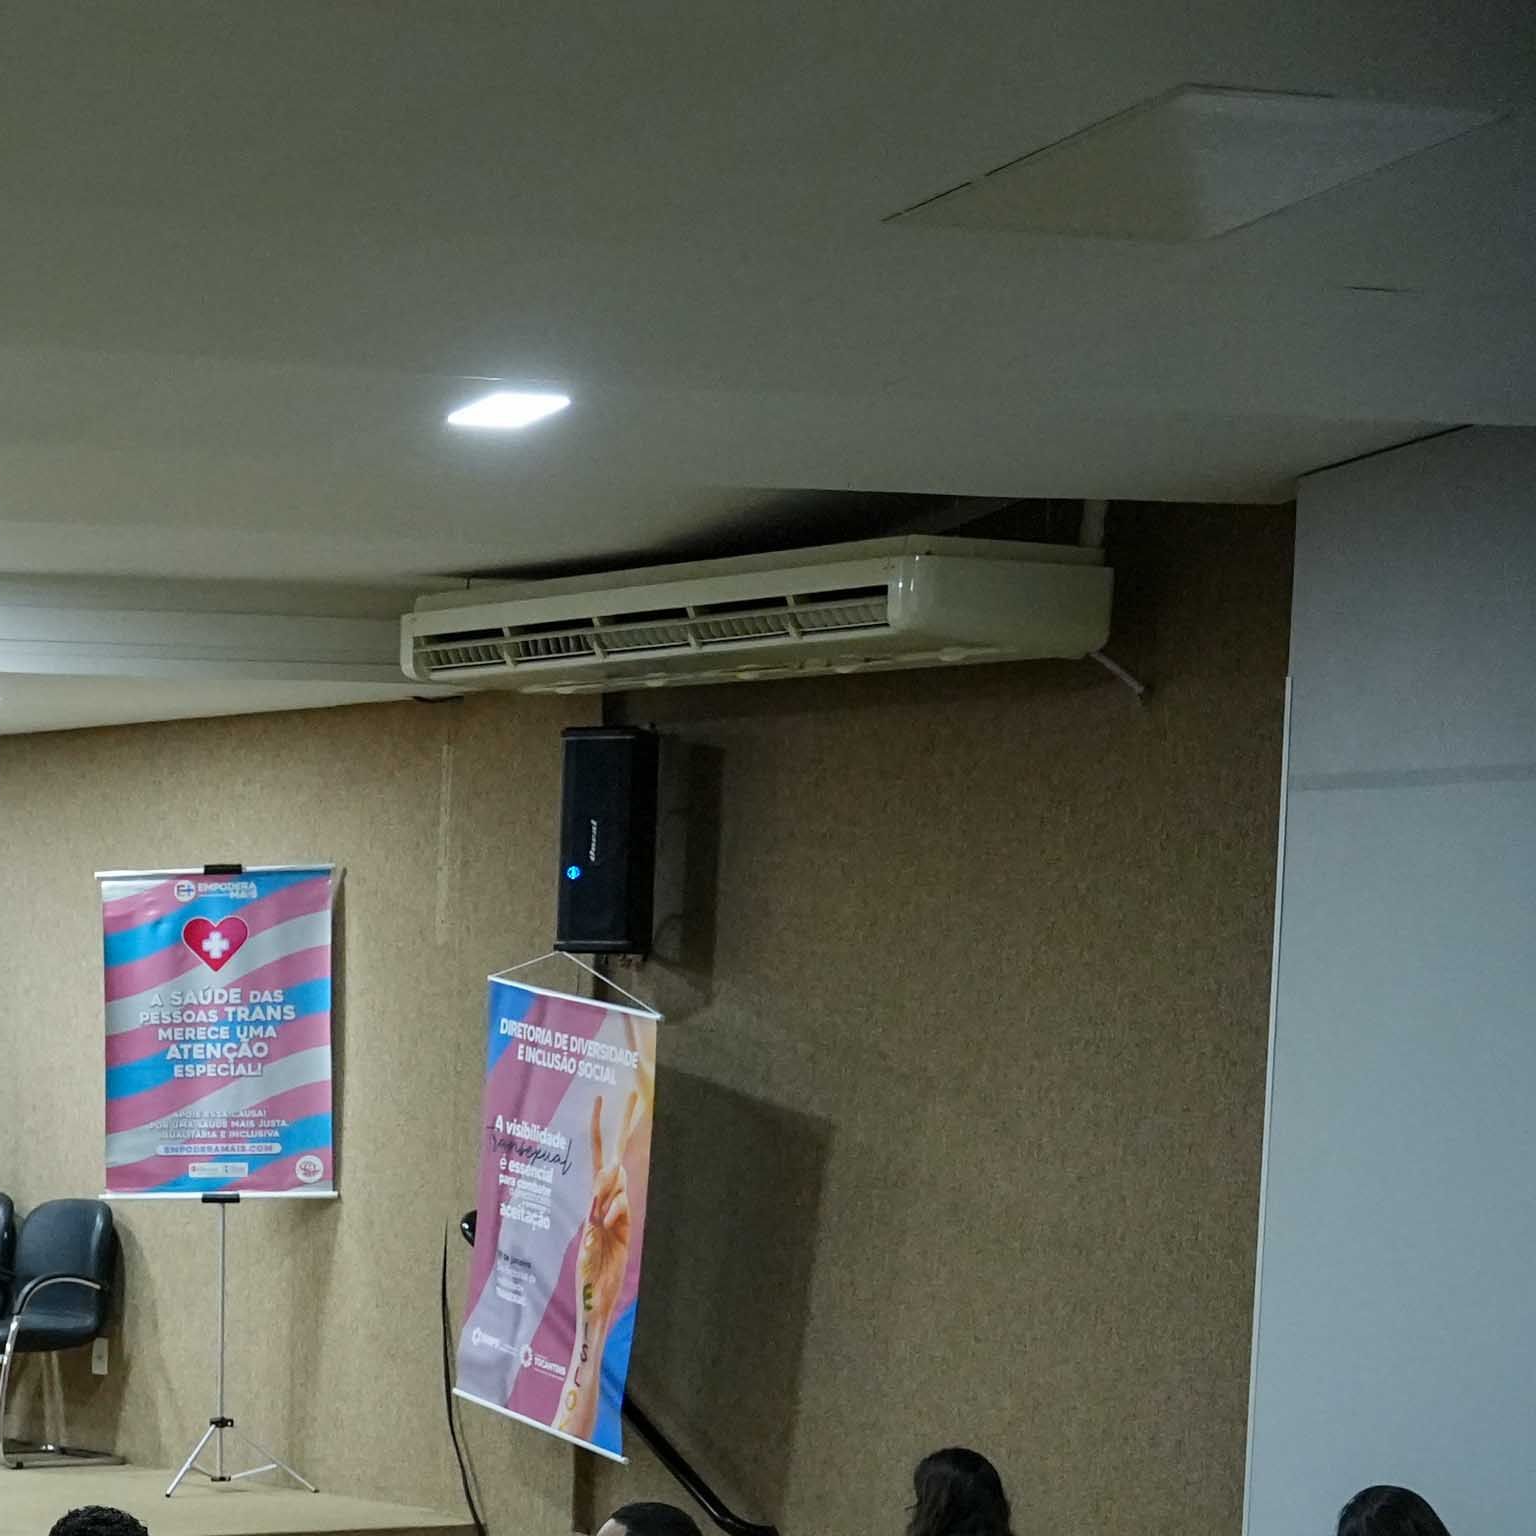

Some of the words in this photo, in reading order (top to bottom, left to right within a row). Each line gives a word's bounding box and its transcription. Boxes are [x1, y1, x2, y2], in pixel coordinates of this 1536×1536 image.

[150, 994, 163, 1008] A
[170, 985, 242, 1007] SAÚDE
[249, 989, 284, 1003] DAS
[139, 1009, 219, 1025] PESSOAS
[223, 1004, 297, 1022] TRANS
[158, 1026, 230, 1041] MERECE
[236, 1025, 278, 1039] UMA
[499, 1017, 553, 1047] DIRETORIA
[553, 1031, 569, 1050] DE
[570, 1036, 639, 1069] DIVERSIDADE
[166, 1038, 269, 1063] ATENÇÃO
[173, 1062, 263, 1078] ESPECIAL!
[517, 1043, 525, 1061] E
[525, 1045, 577, 1075] INCLUSÃO
[577, 1060, 617, 1085] SOCIAL
[495, 1114, 504, 1133] A
[505, 1117, 569, 1150] visibilidade
